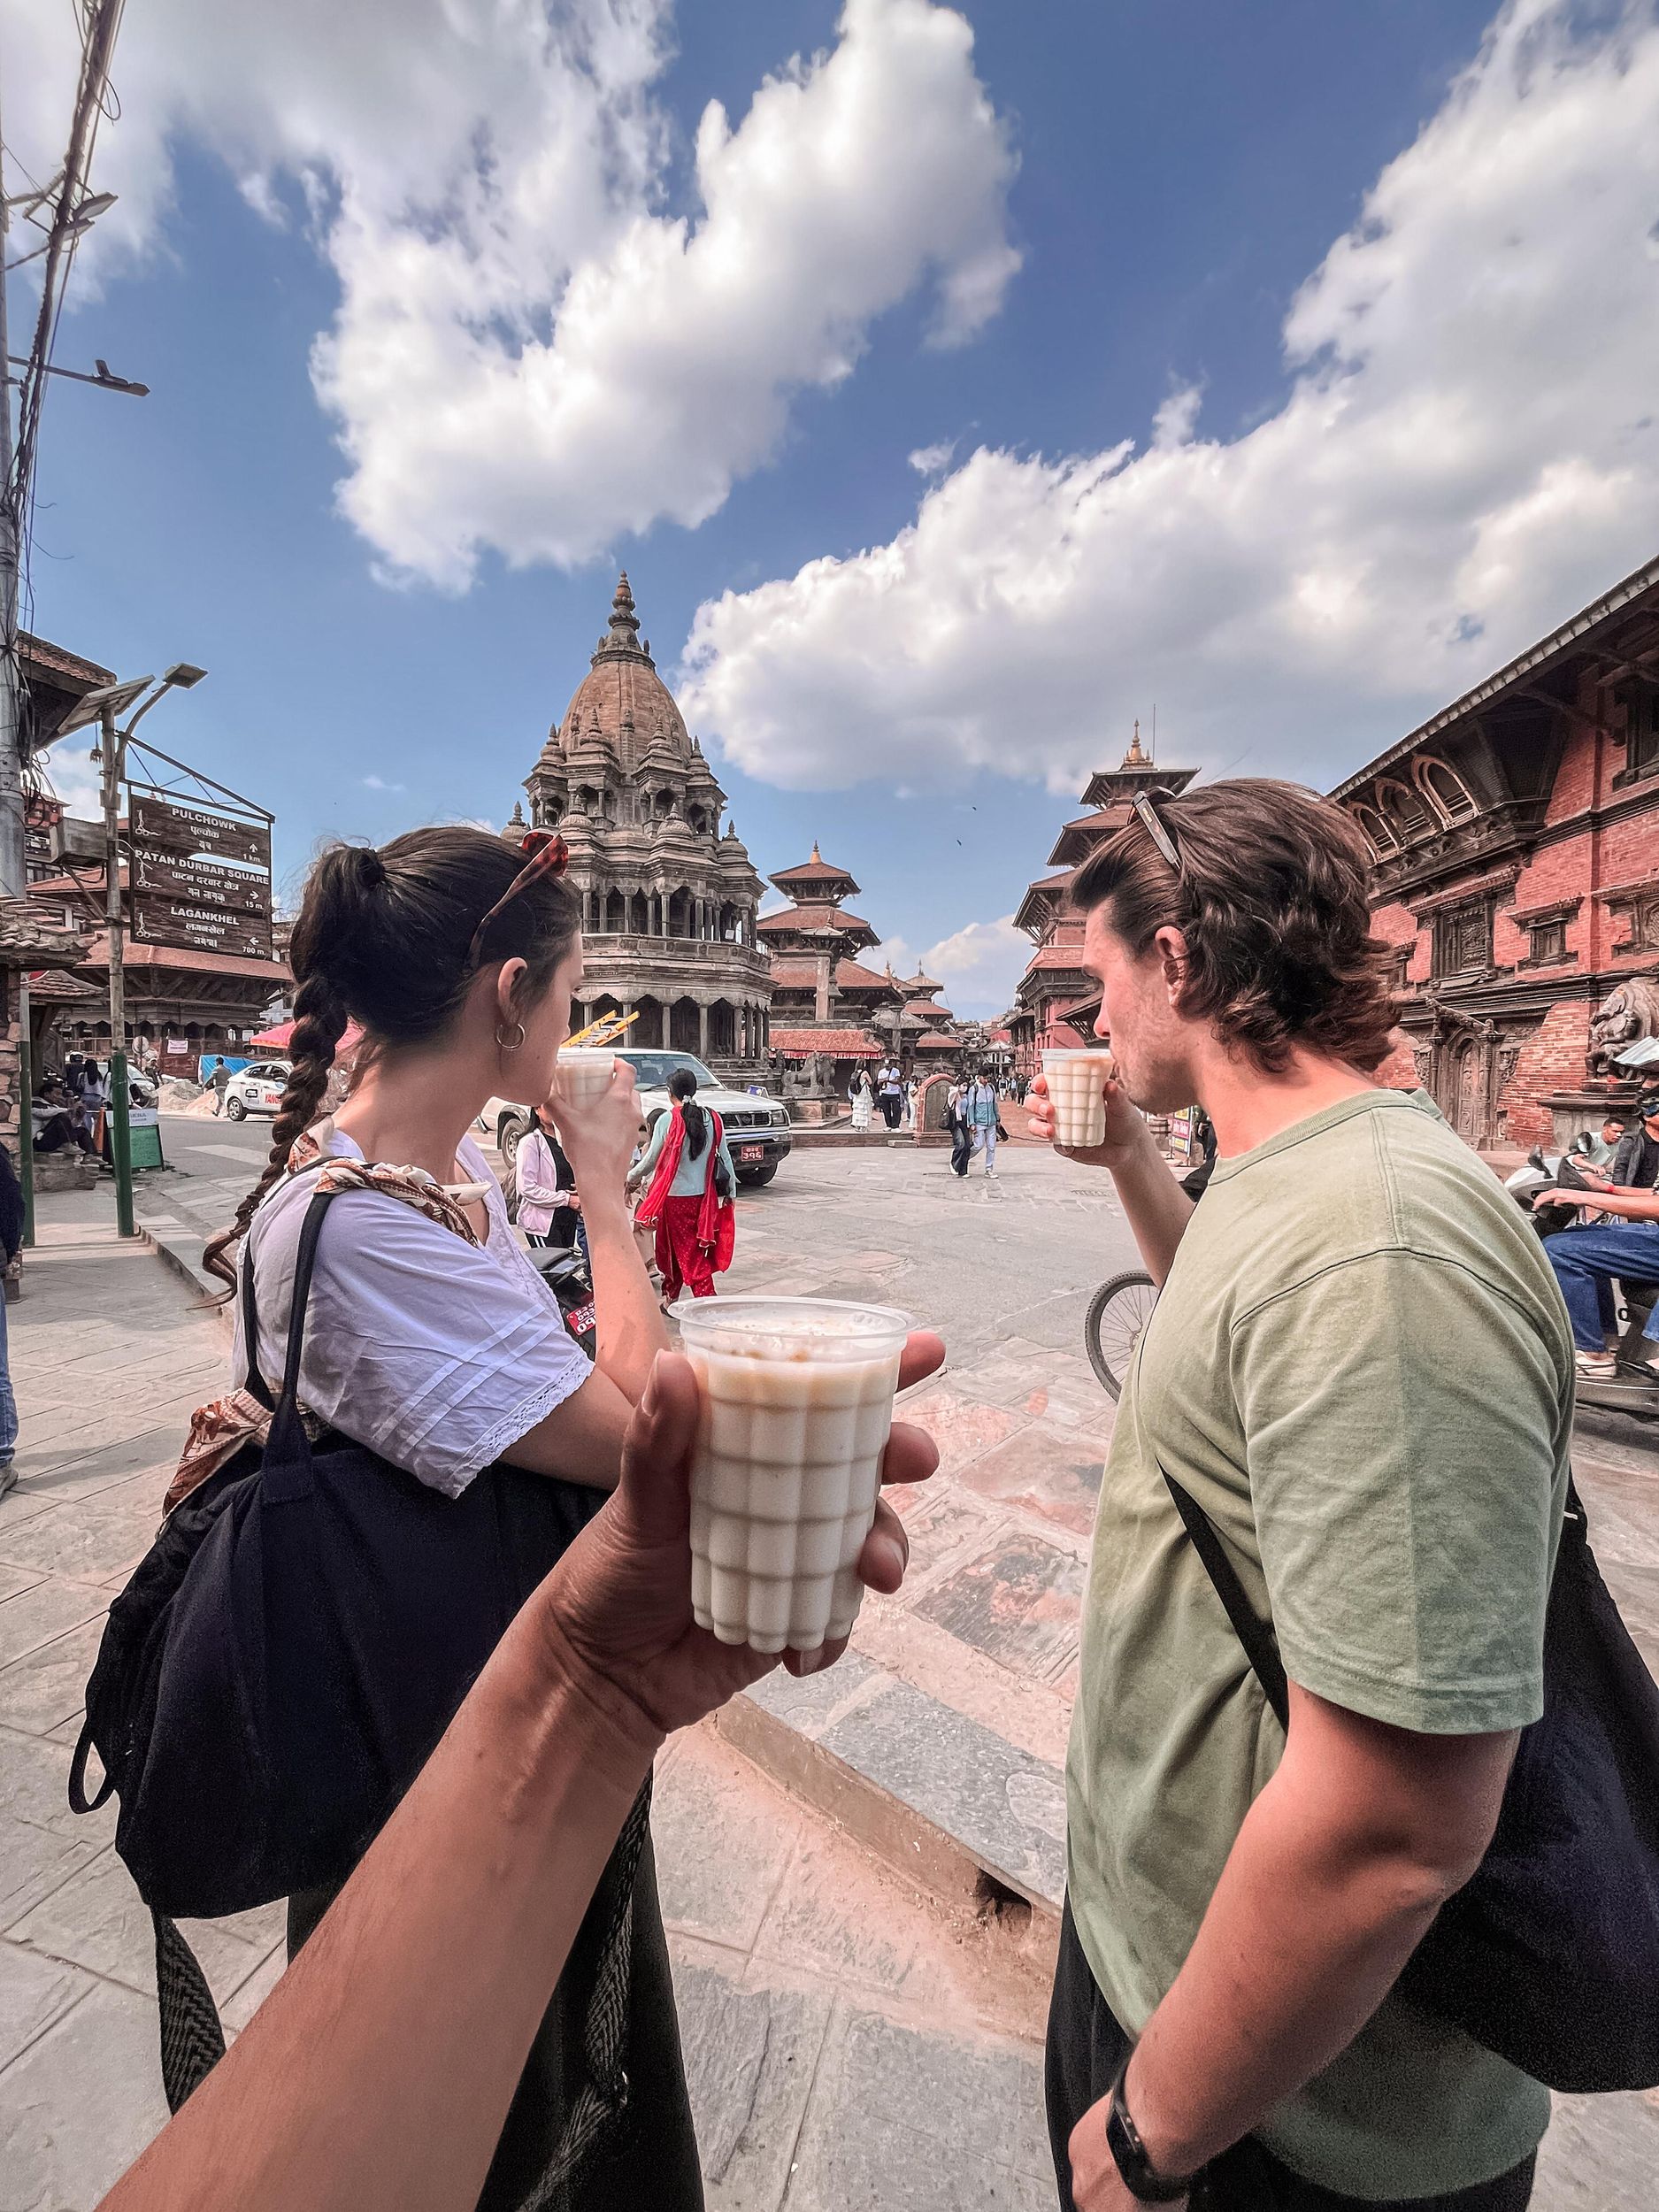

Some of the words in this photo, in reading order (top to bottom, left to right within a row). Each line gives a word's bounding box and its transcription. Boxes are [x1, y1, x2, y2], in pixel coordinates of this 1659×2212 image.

[172, 807, 237, 832] PULCHOWK
[134, 849, 176, 865] PATAN
[179, 858, 225, 876] DURBAR
[227, 869, 269, 885] SQUARE
[170, 906, 240, 926] LAGANKHEL
